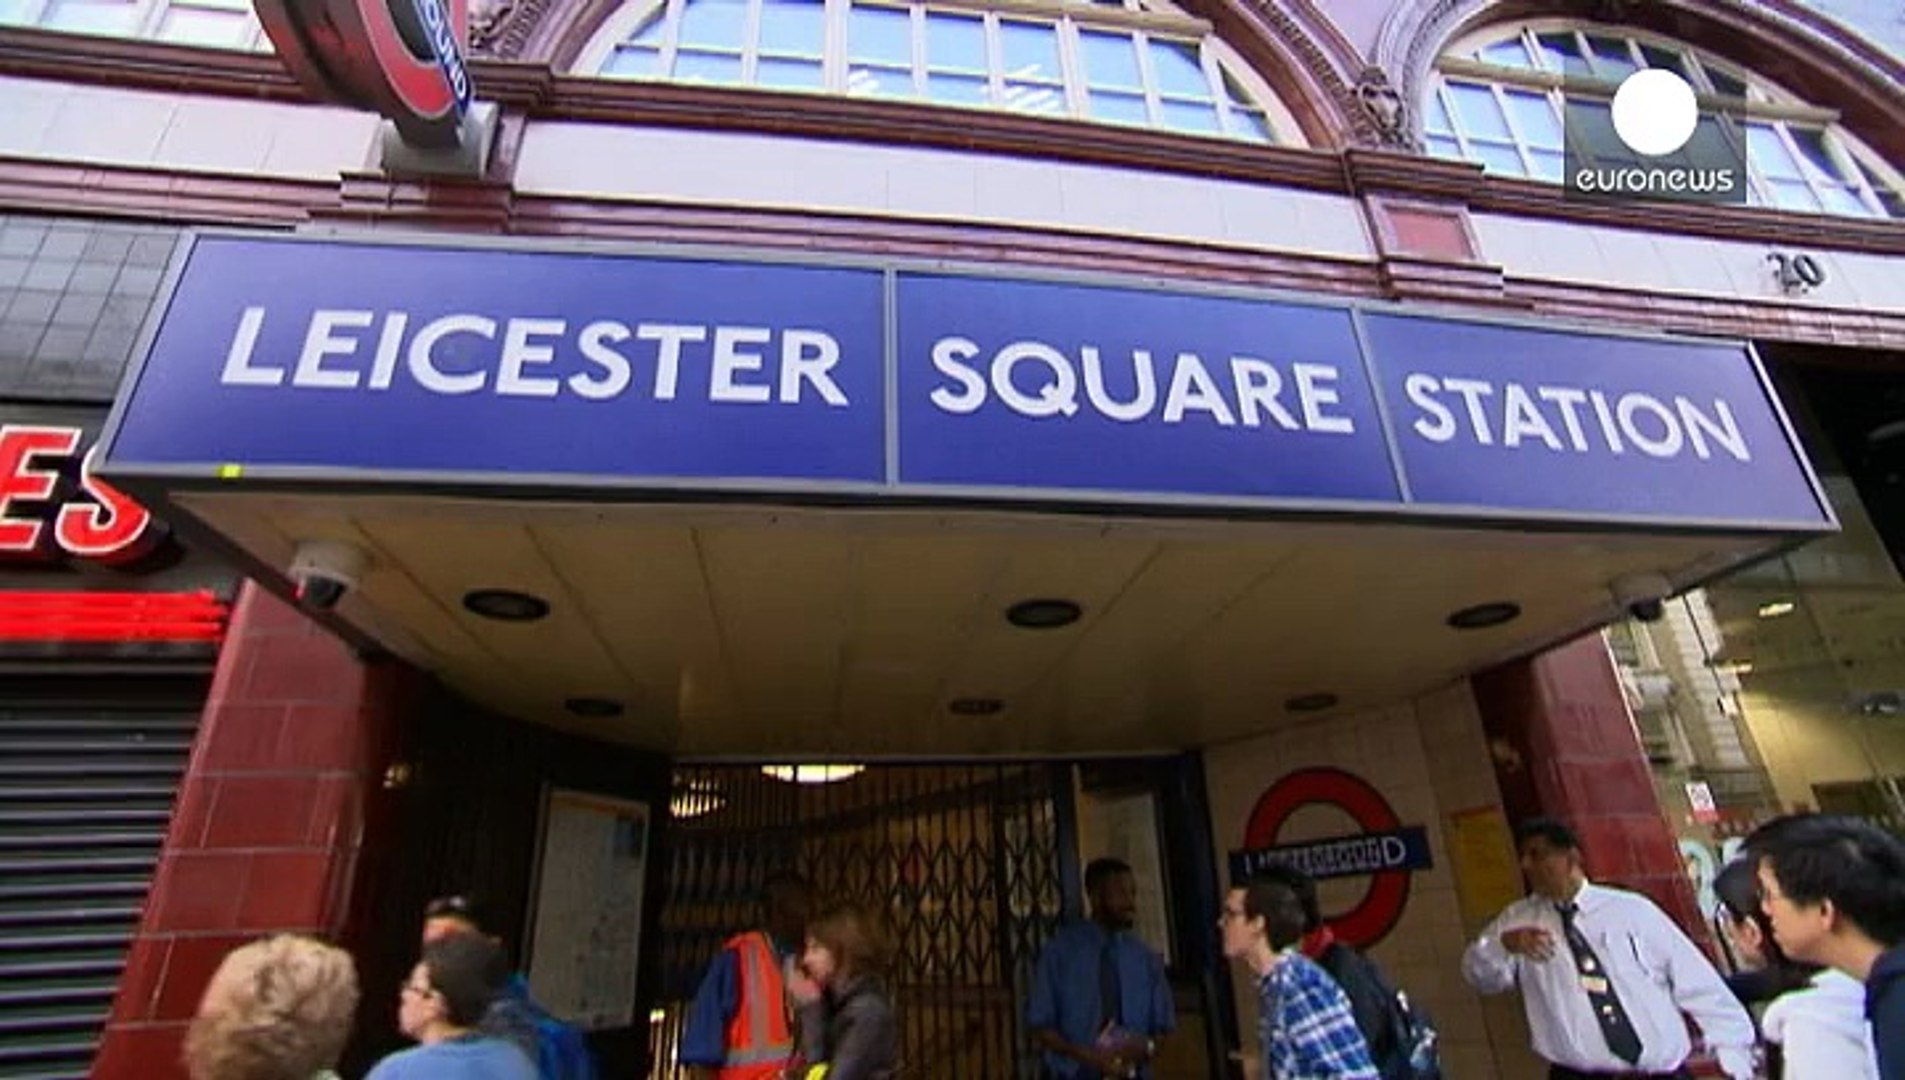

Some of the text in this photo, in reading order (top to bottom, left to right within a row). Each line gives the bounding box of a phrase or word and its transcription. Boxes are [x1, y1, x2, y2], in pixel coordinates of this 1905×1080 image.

[1765, 252, 1824, 288] 20
[221, 306, 1751, 461] LEICESTER SQUARE STATION
